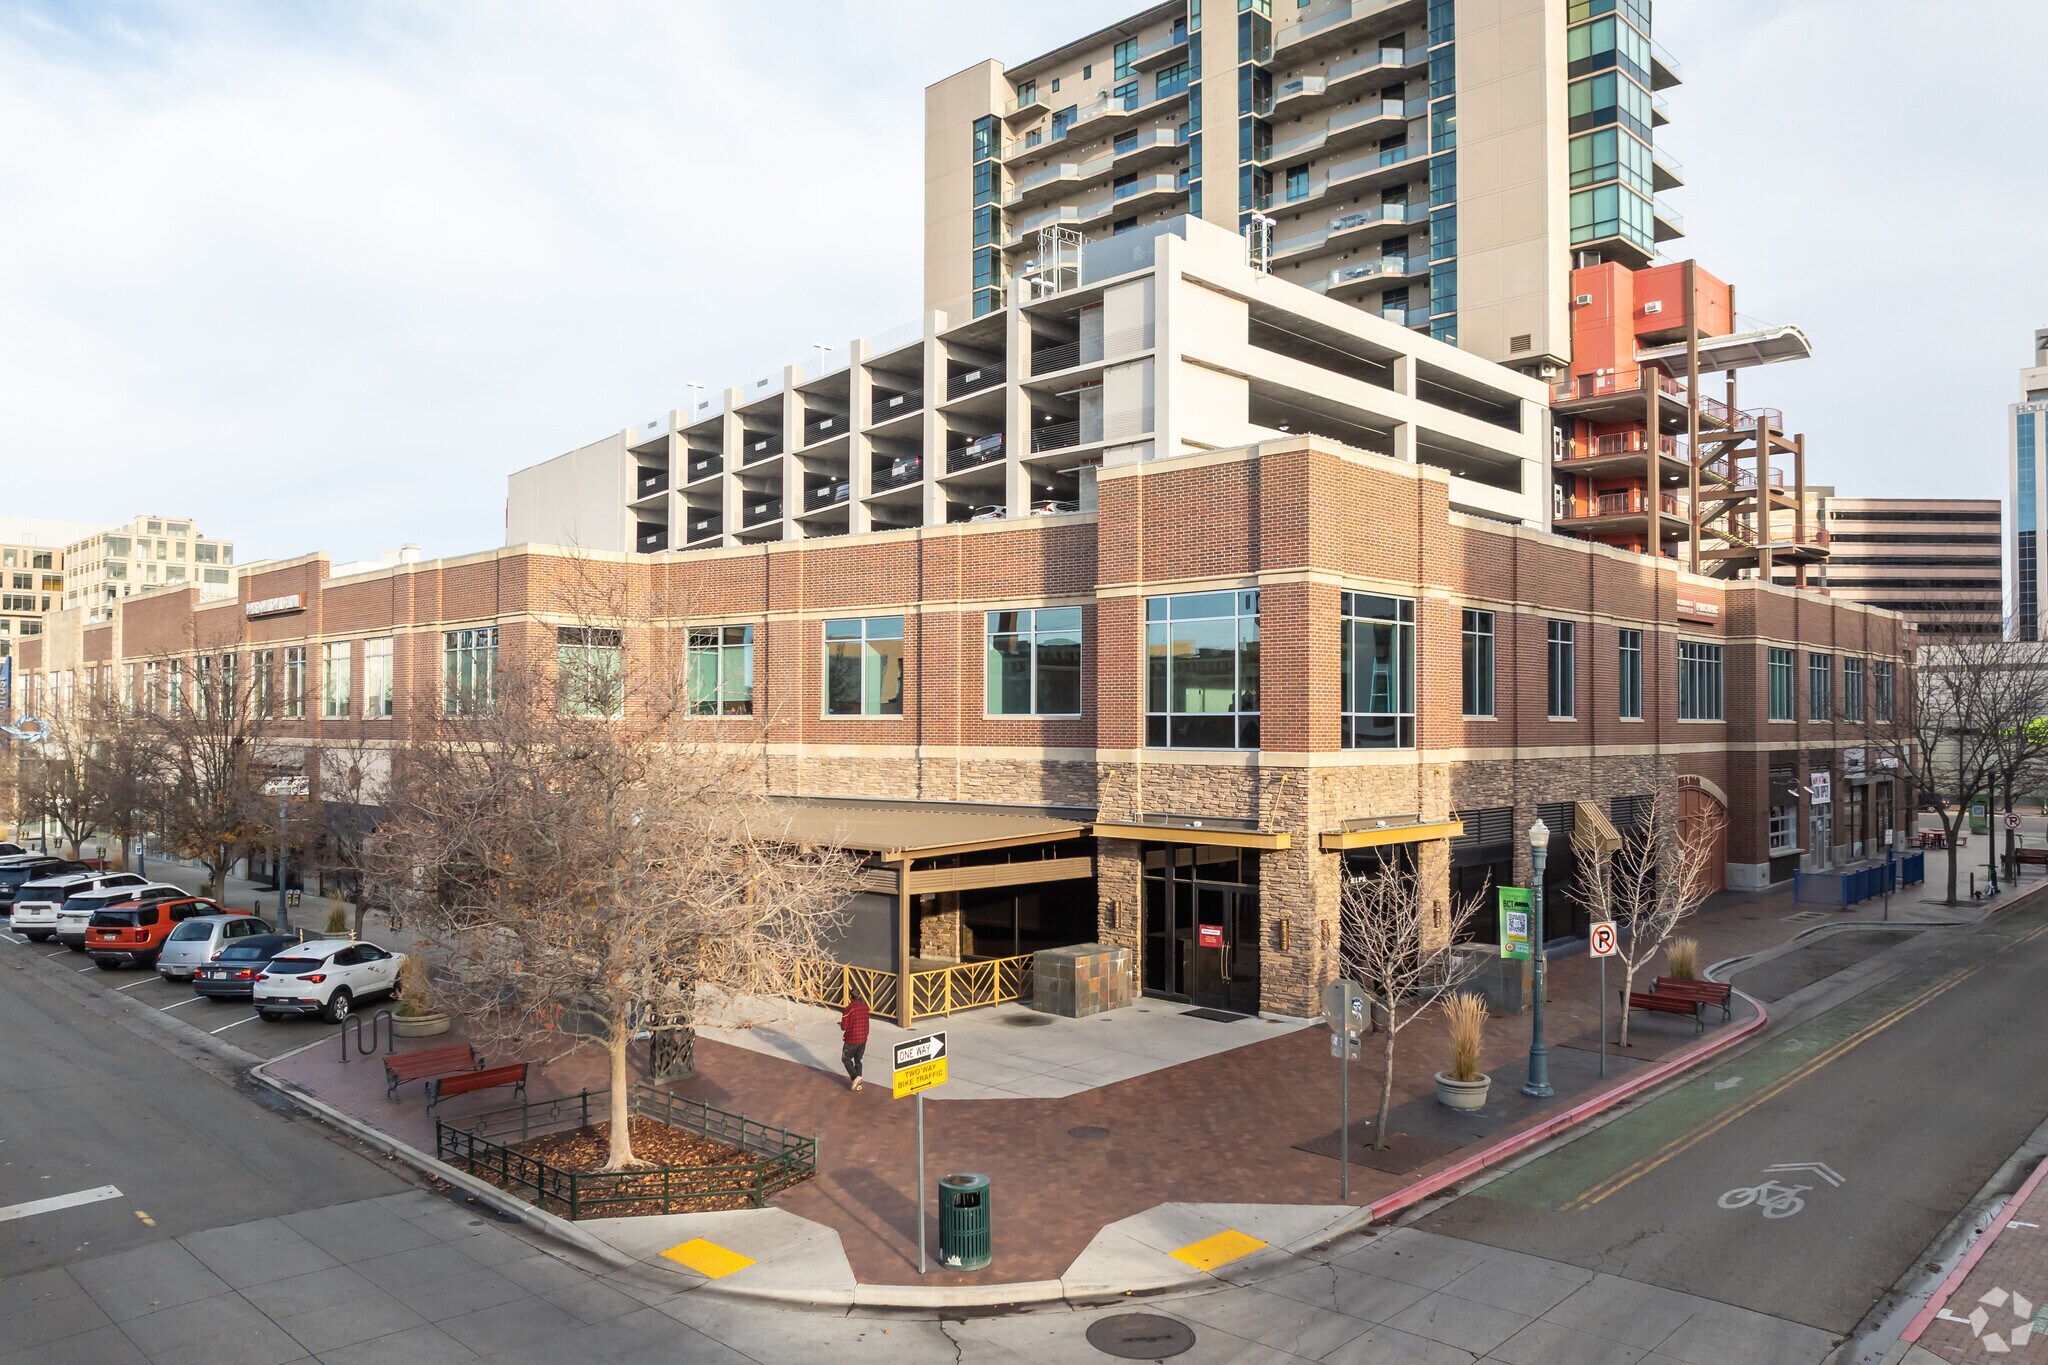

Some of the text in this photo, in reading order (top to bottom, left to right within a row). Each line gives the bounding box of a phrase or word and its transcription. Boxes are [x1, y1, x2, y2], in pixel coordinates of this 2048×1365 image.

[1599, 930, 1610, 948] P
[899, 1044, 931, 1061] ONE WAY
[897, 1069, 943, 1089] BIKE TRAFFIC
[905, 1063, 936, 1078] TWO WAY
